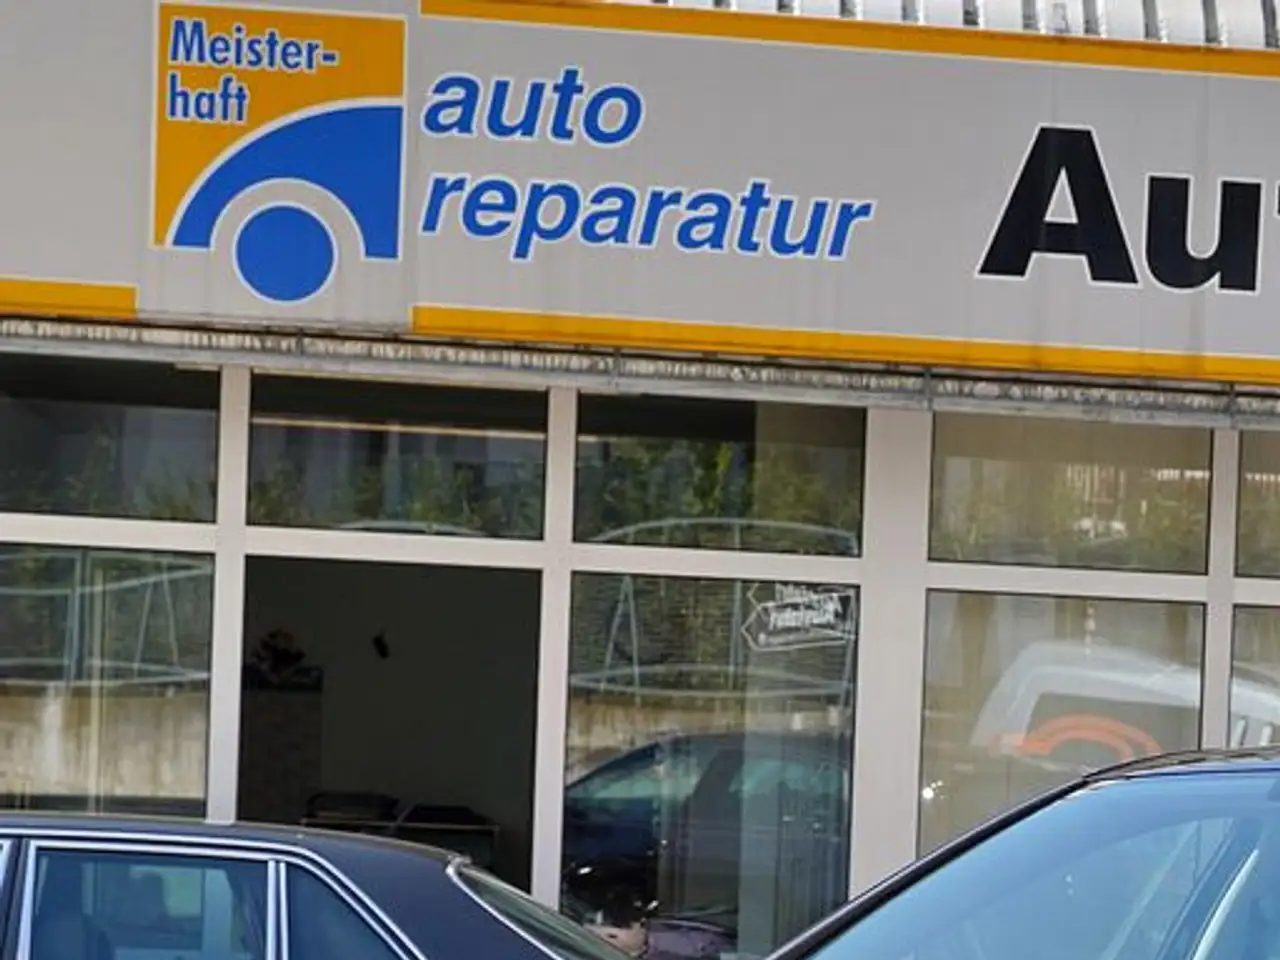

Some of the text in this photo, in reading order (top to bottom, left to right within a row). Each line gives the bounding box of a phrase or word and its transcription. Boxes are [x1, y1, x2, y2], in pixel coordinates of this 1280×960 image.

[169, 19, 338, 70] Meister-
[168, 73, 248, 122] haft
[421, 65, 644, 146] auto
[421, 174, 874, 261] reparatur
